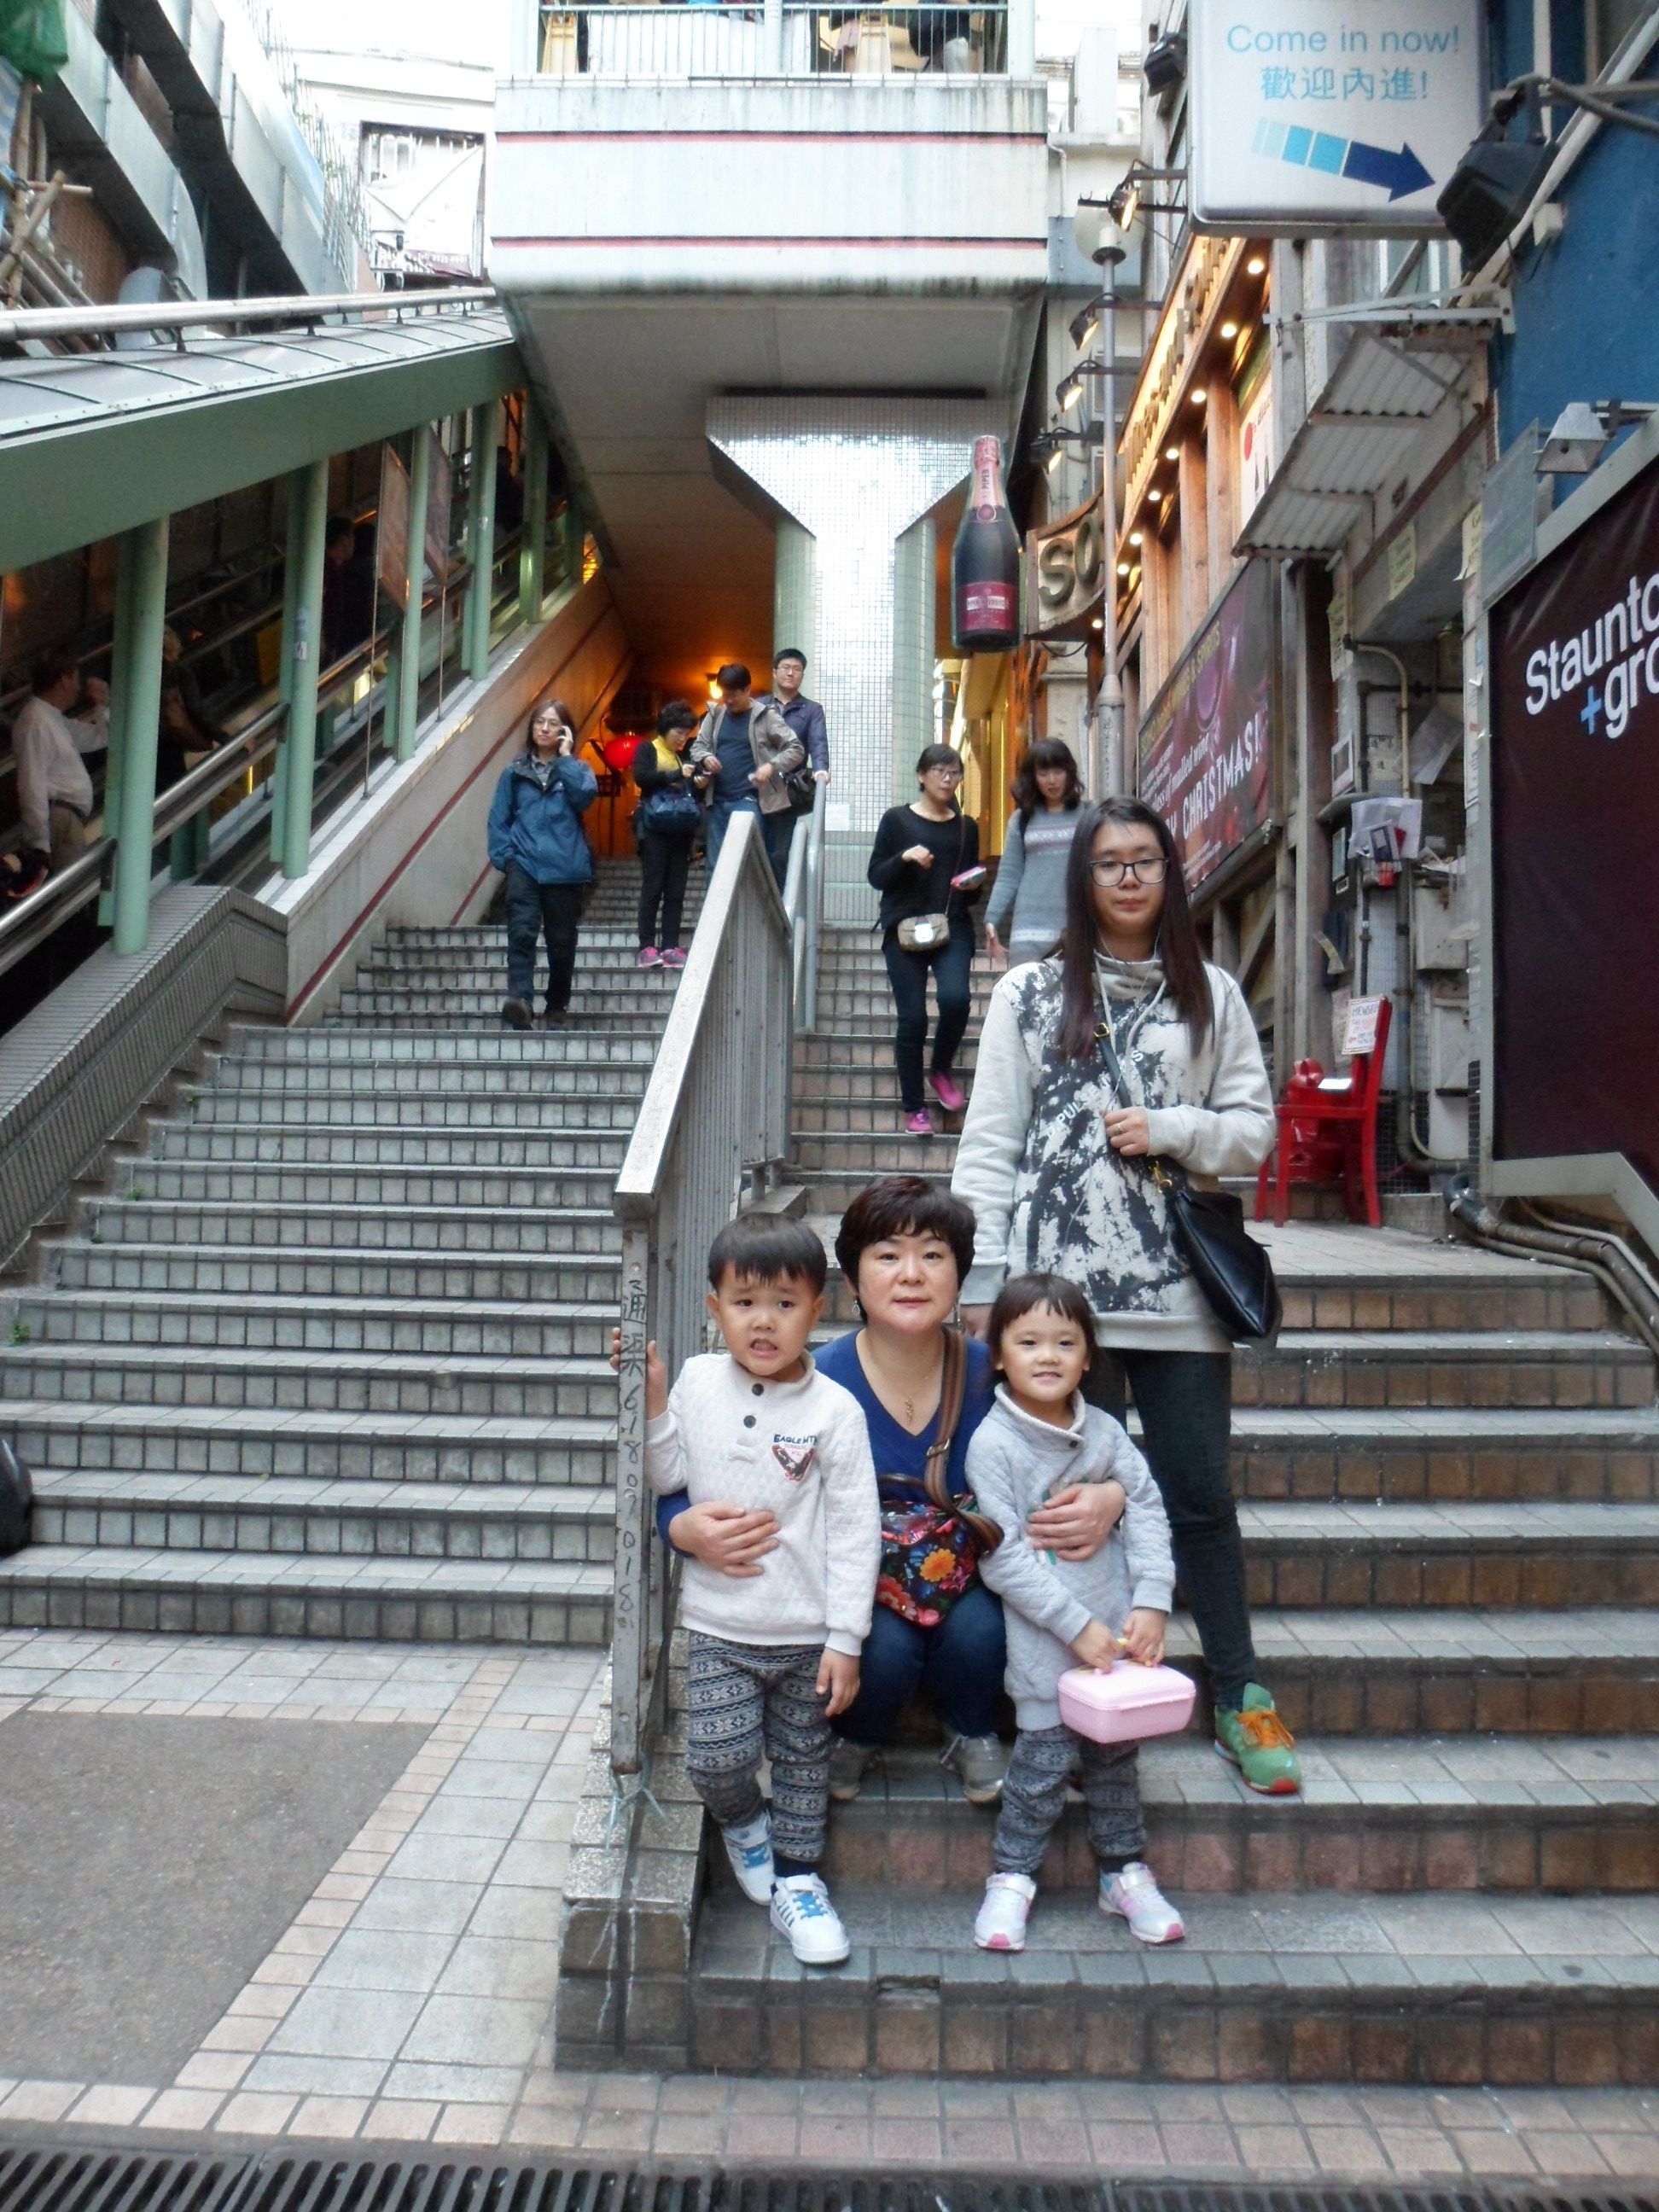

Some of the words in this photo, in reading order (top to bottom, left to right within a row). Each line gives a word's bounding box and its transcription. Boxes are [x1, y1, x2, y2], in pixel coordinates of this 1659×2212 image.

[1226, 25, 1327, 53] Come
[1340, 25, 1366, 52] in
[1381, 25, 1459, 53] now!
[1183, 713, 1260, 840] CHRISTMAS!
